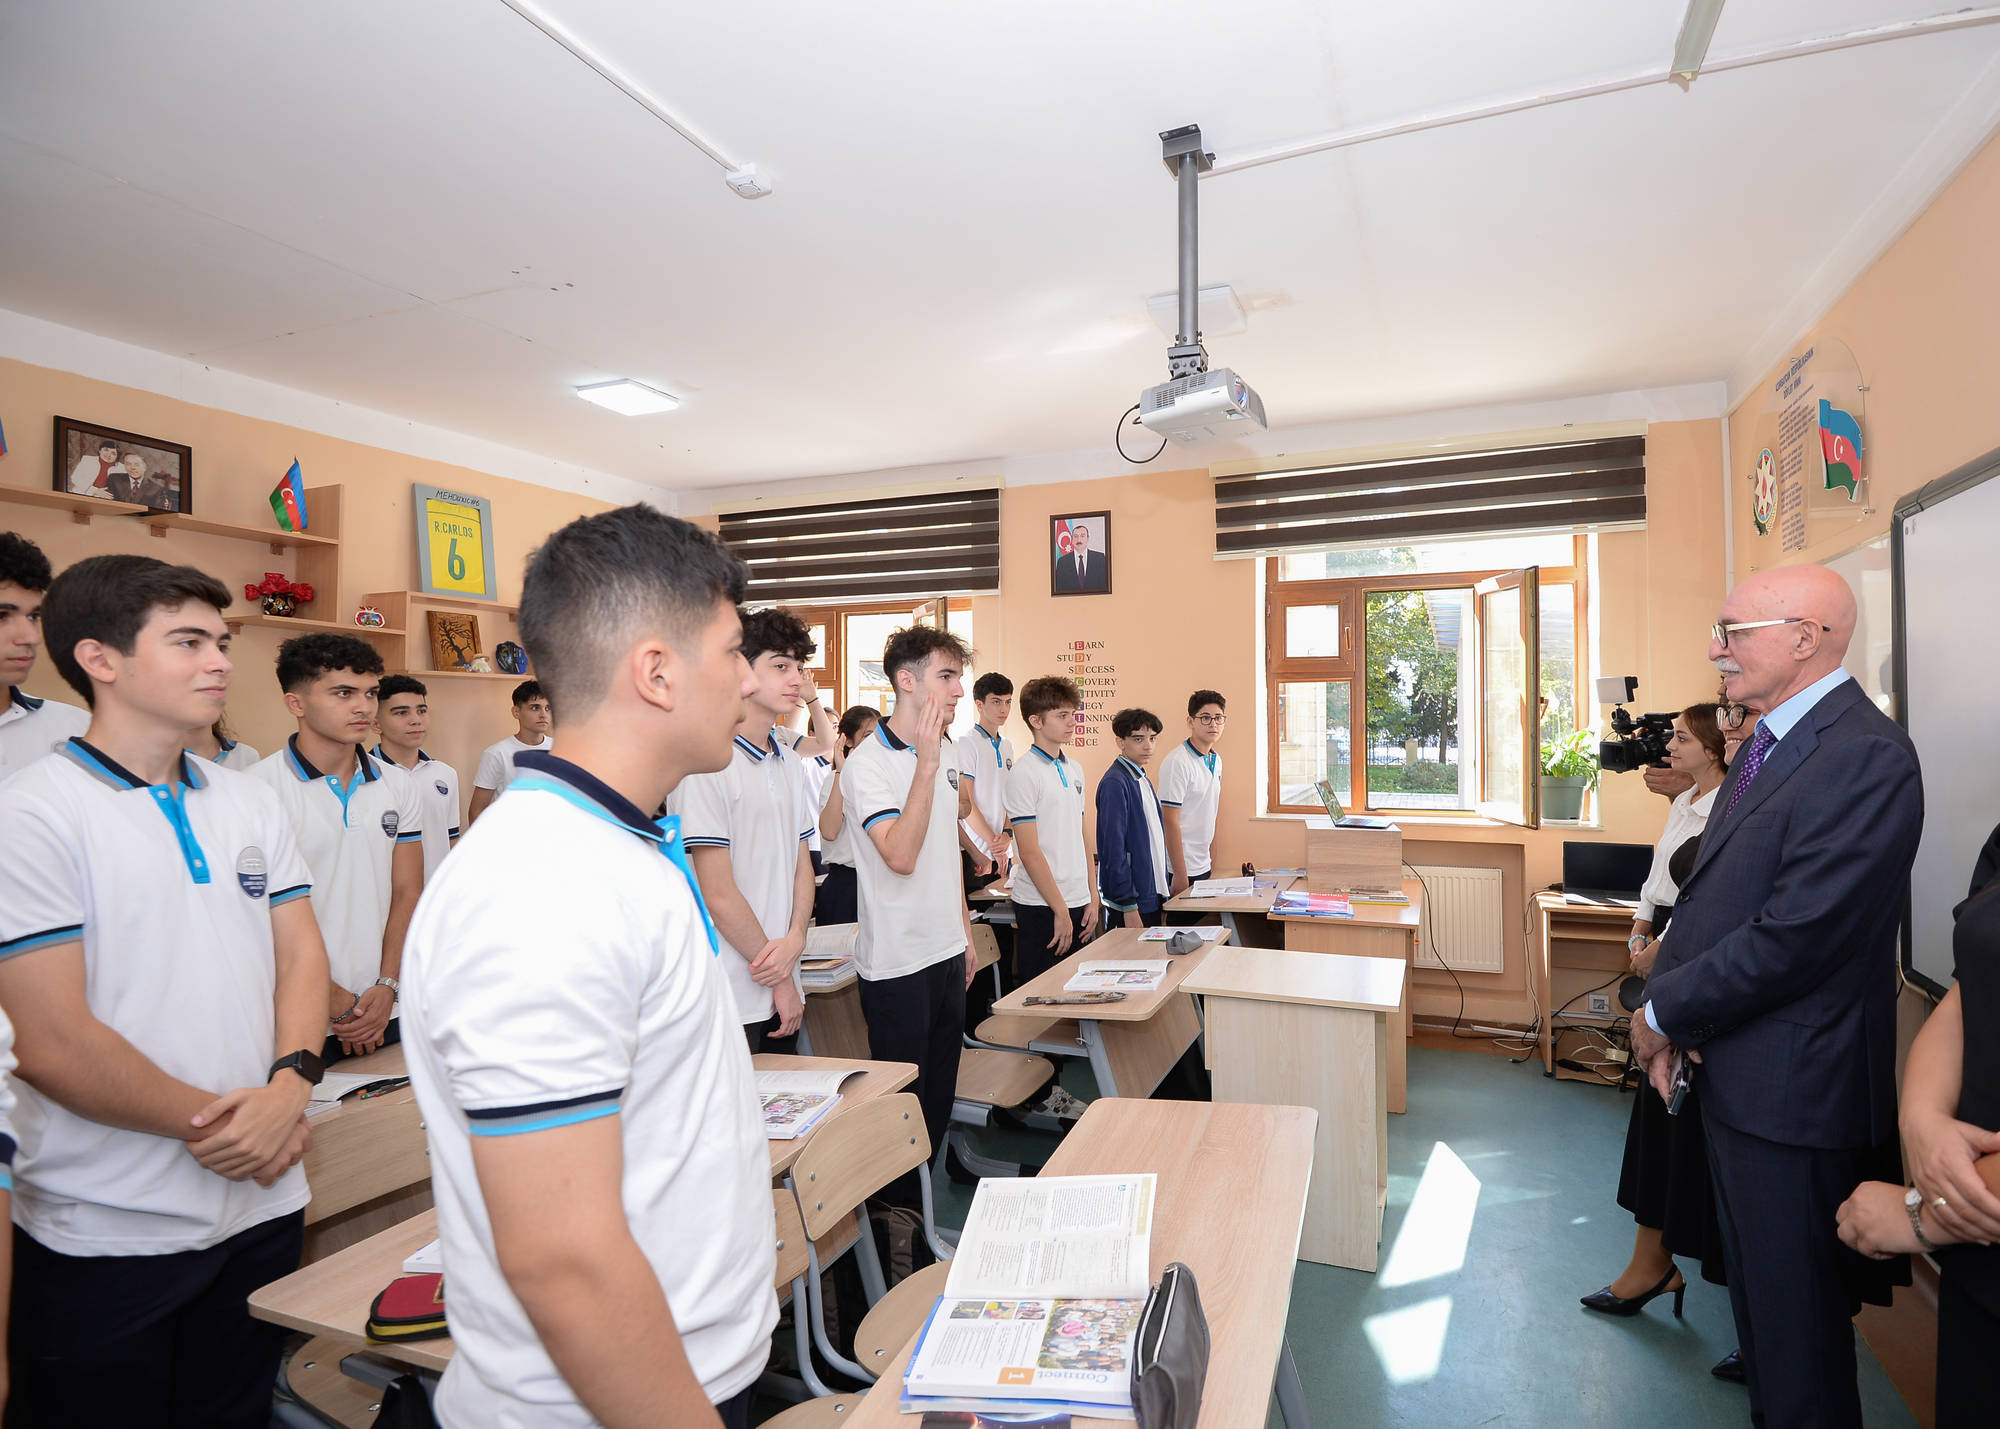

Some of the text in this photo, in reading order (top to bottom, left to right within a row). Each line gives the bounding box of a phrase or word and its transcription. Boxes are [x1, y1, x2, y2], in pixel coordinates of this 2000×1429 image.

[434, 521, 473, 538] R.CARLOS
[448, 538, 466, 581] 6
[1068, 641, 1105, 650] LEARN
[1056, 653, 1092, 662] STUDY
[1068, 665, 1115, 674] SUCCESS
[1074, 677, 1117, 686] COVERY
[1075, 725, 1099, 735] ORK
[1037, 1371, 1108, 1384] Connect
